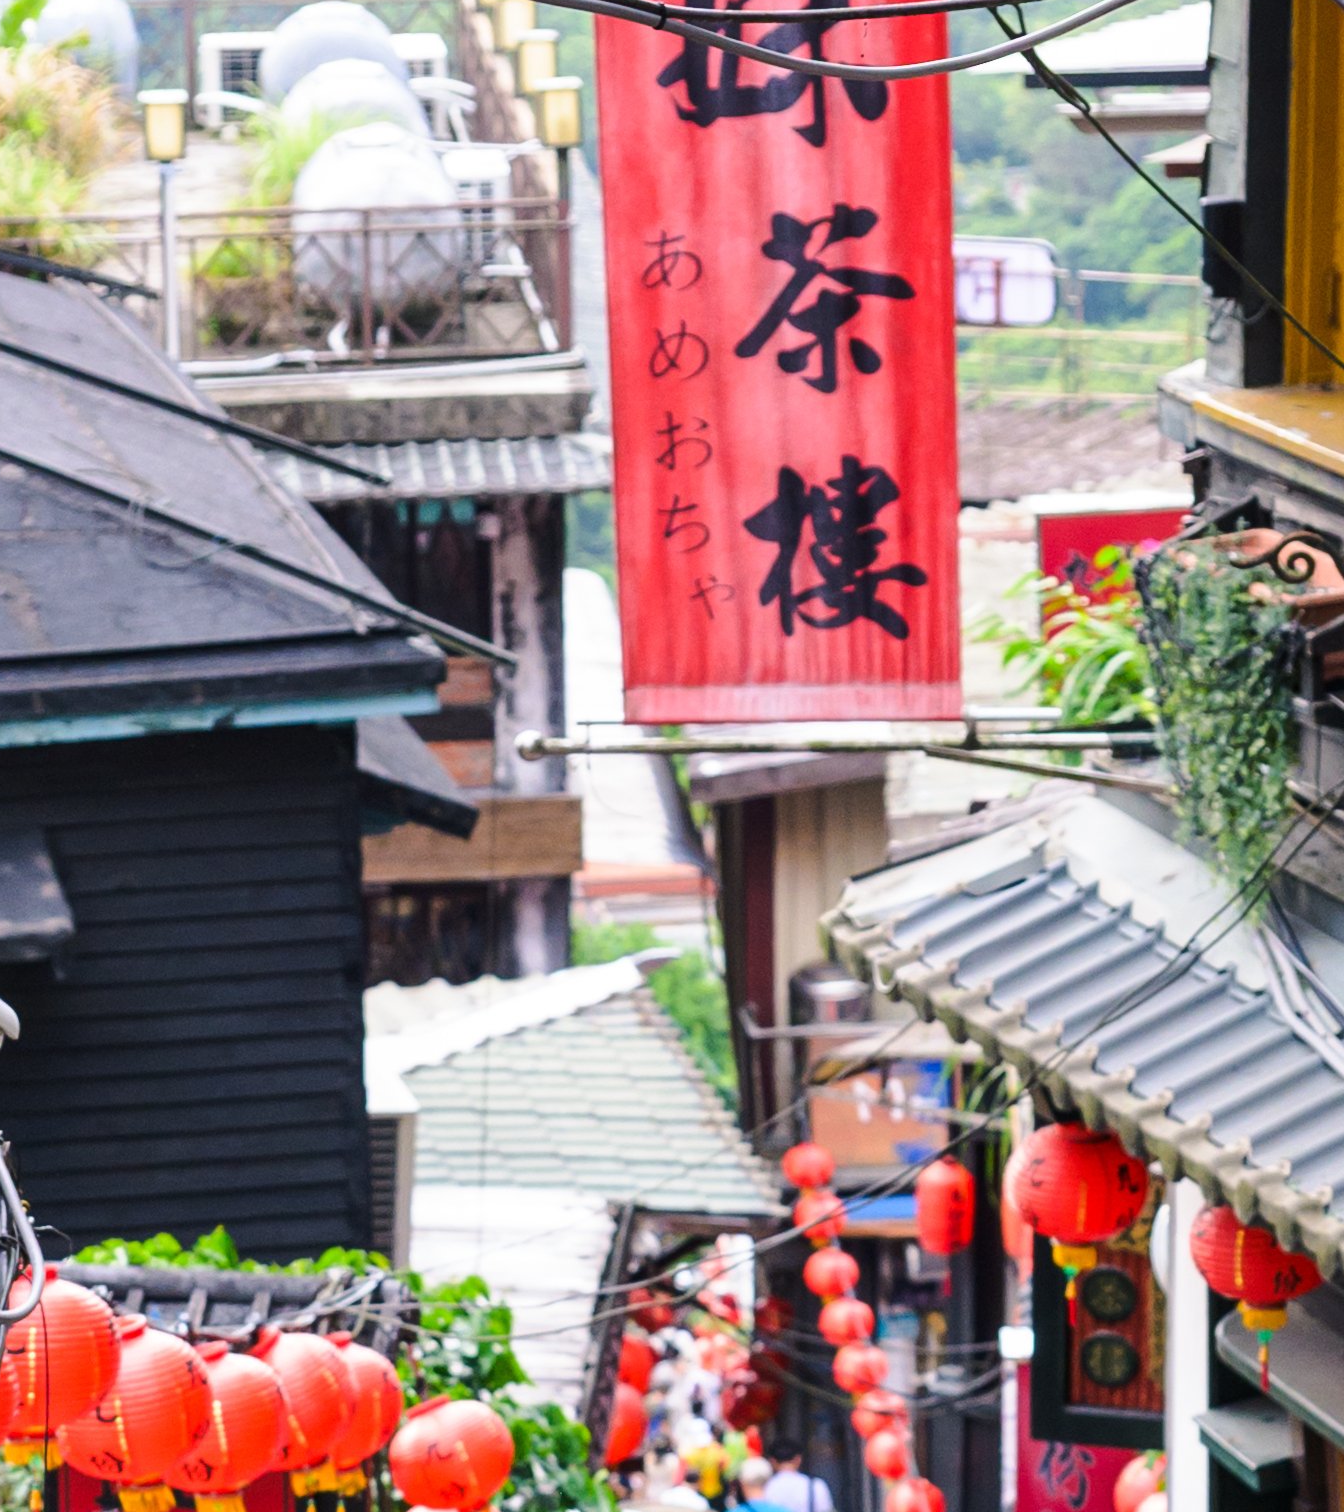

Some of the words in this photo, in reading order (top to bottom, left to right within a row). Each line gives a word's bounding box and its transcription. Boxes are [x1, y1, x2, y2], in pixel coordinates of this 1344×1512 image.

[641, 230, 736, 620] あめおちゃ
